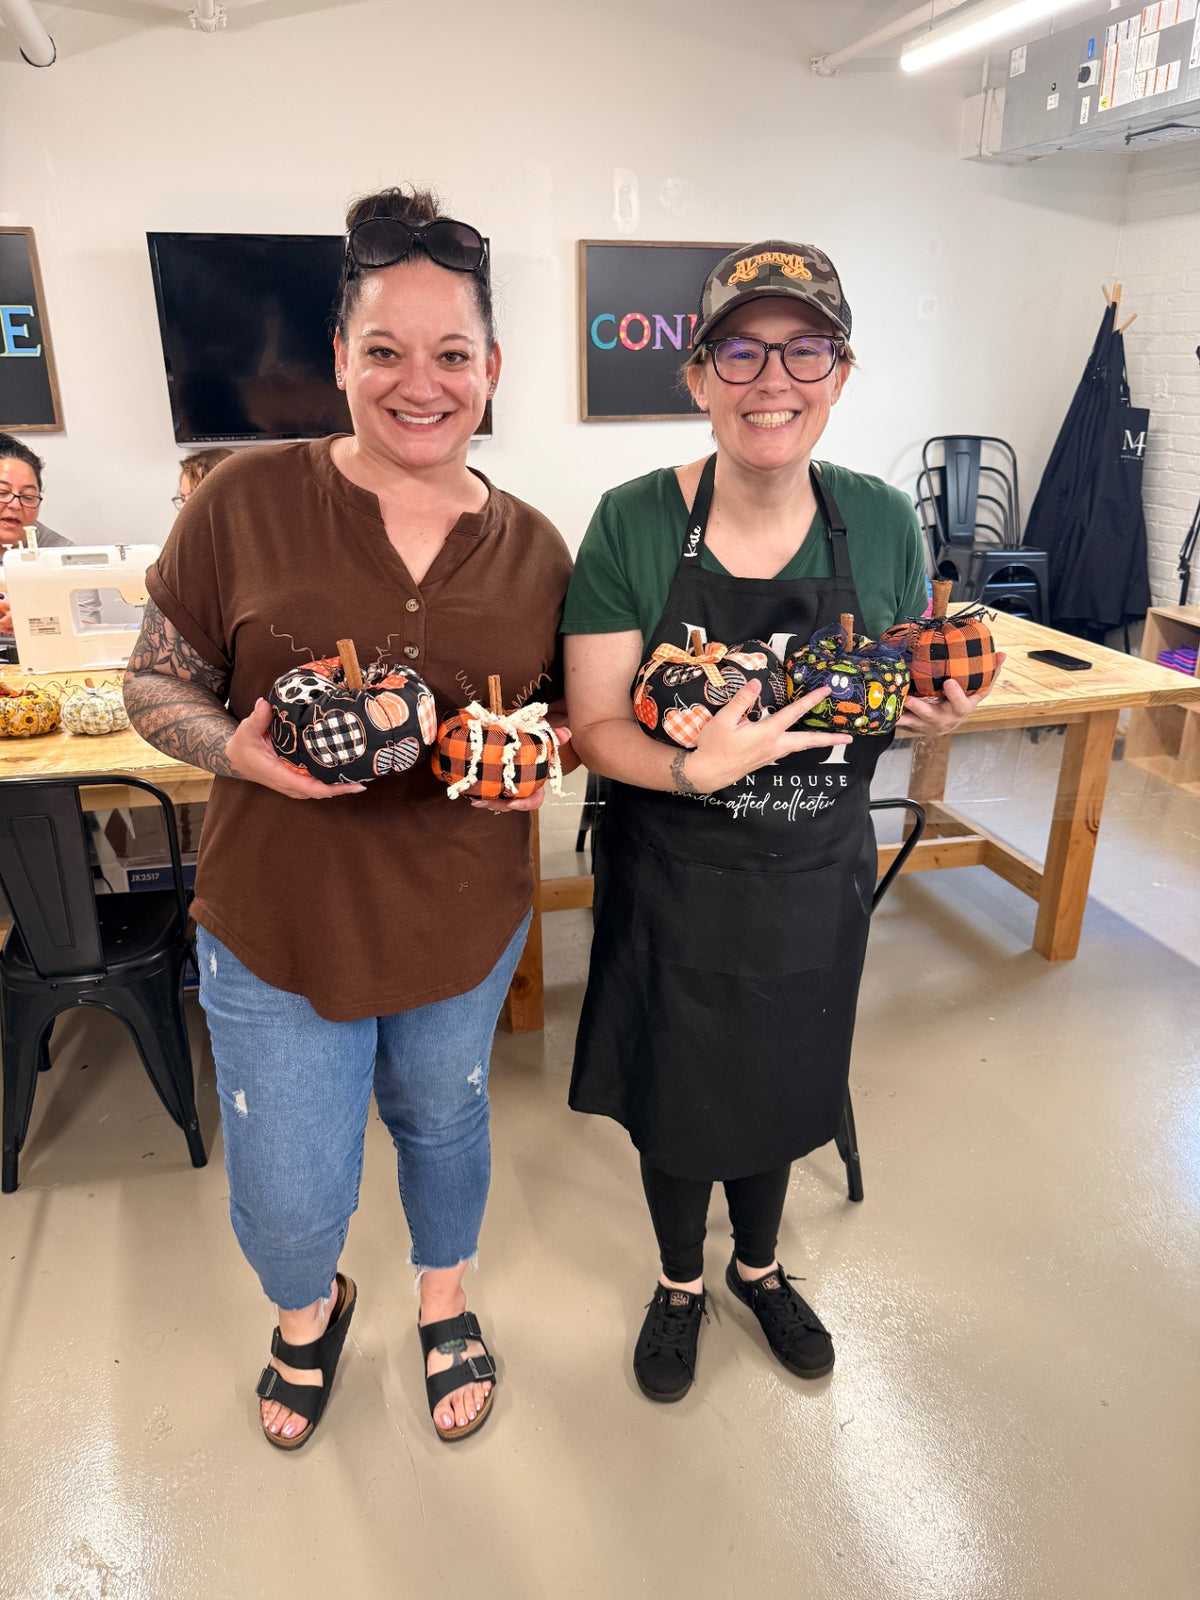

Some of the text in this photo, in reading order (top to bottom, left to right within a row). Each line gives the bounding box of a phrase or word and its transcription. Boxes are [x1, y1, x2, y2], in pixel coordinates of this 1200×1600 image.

[728, 252, 812, 286] ALABAMA
[590, 312, 699, 351] CON
[683, 525, 702, 557] Kate
[773, 775, 848, 787] HOUSE
[667, 790, 770, 819] andcrafted
